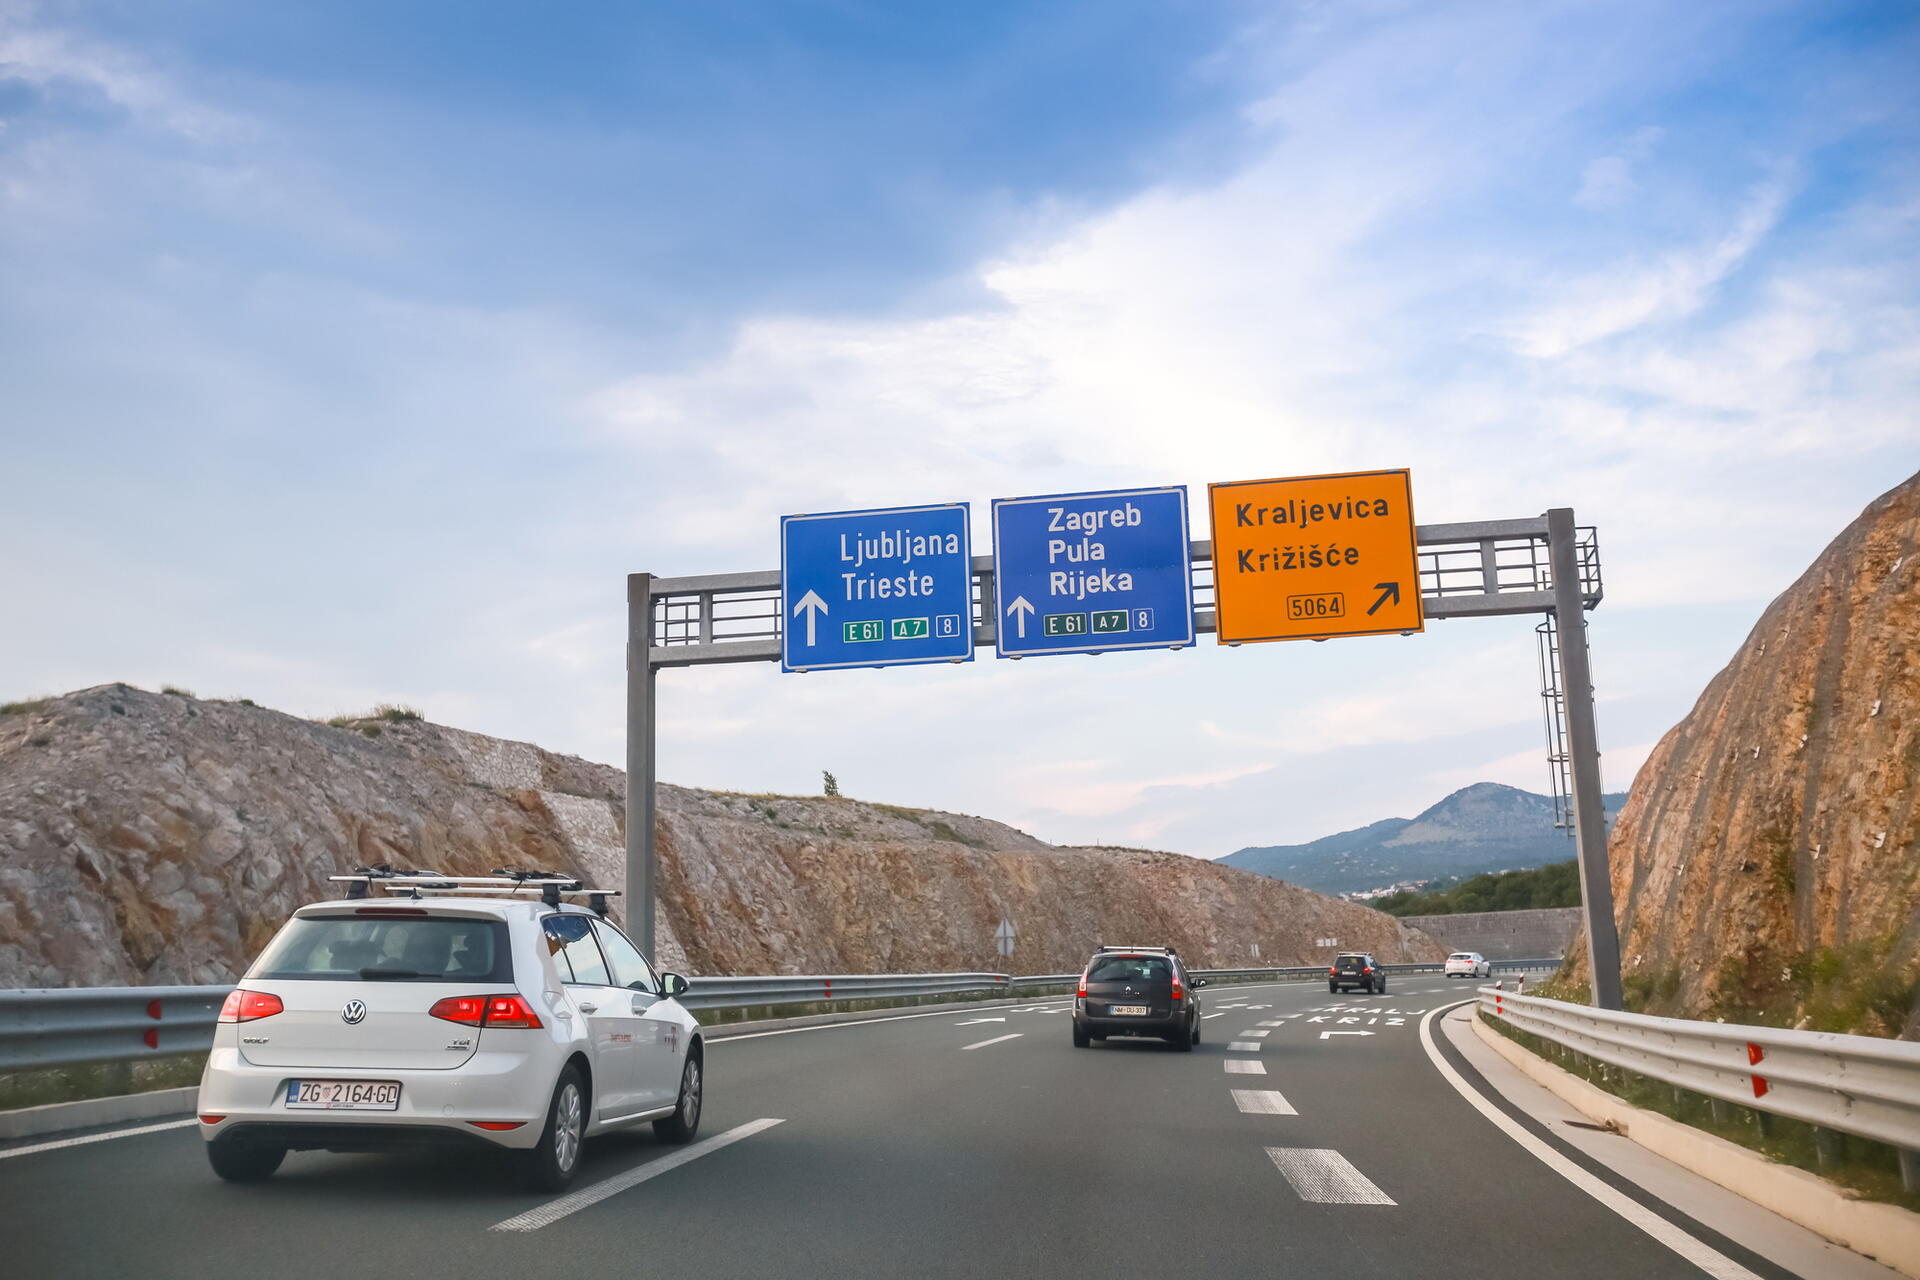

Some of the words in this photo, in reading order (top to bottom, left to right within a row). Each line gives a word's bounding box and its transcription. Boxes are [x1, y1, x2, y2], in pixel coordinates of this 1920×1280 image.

[1047, 503, 1142, 536] Zagreb
[1236, 496, 1389, 528] Kraljevica
[840, 529, 959, 567] Ljubljana
[1048, 537, 1105, 564] Pula
[1237, 543, 1359, 573] Križišće
[841, 569, 934, 600] Trieste
[1050, 568, 1133, 600] Rijeka
[1292, 597, 1340, 616] 5064
[899, 622, 908, 636] A
[912, 621, 921, 635] 7
[943, 618, 952, 634] 8
[1049, 617, 1058, 633] E
[1065, 615, 1081, 632] 61
[1099, 615, 1108, 628] A
[1111, 615, 1120, 628] 7
[1138, 611, 1148, 628] 8
[849, 624, 857, 640] E
[862, 623, 879, 639] 61
[300, 1084, 321, 1102] ZG
